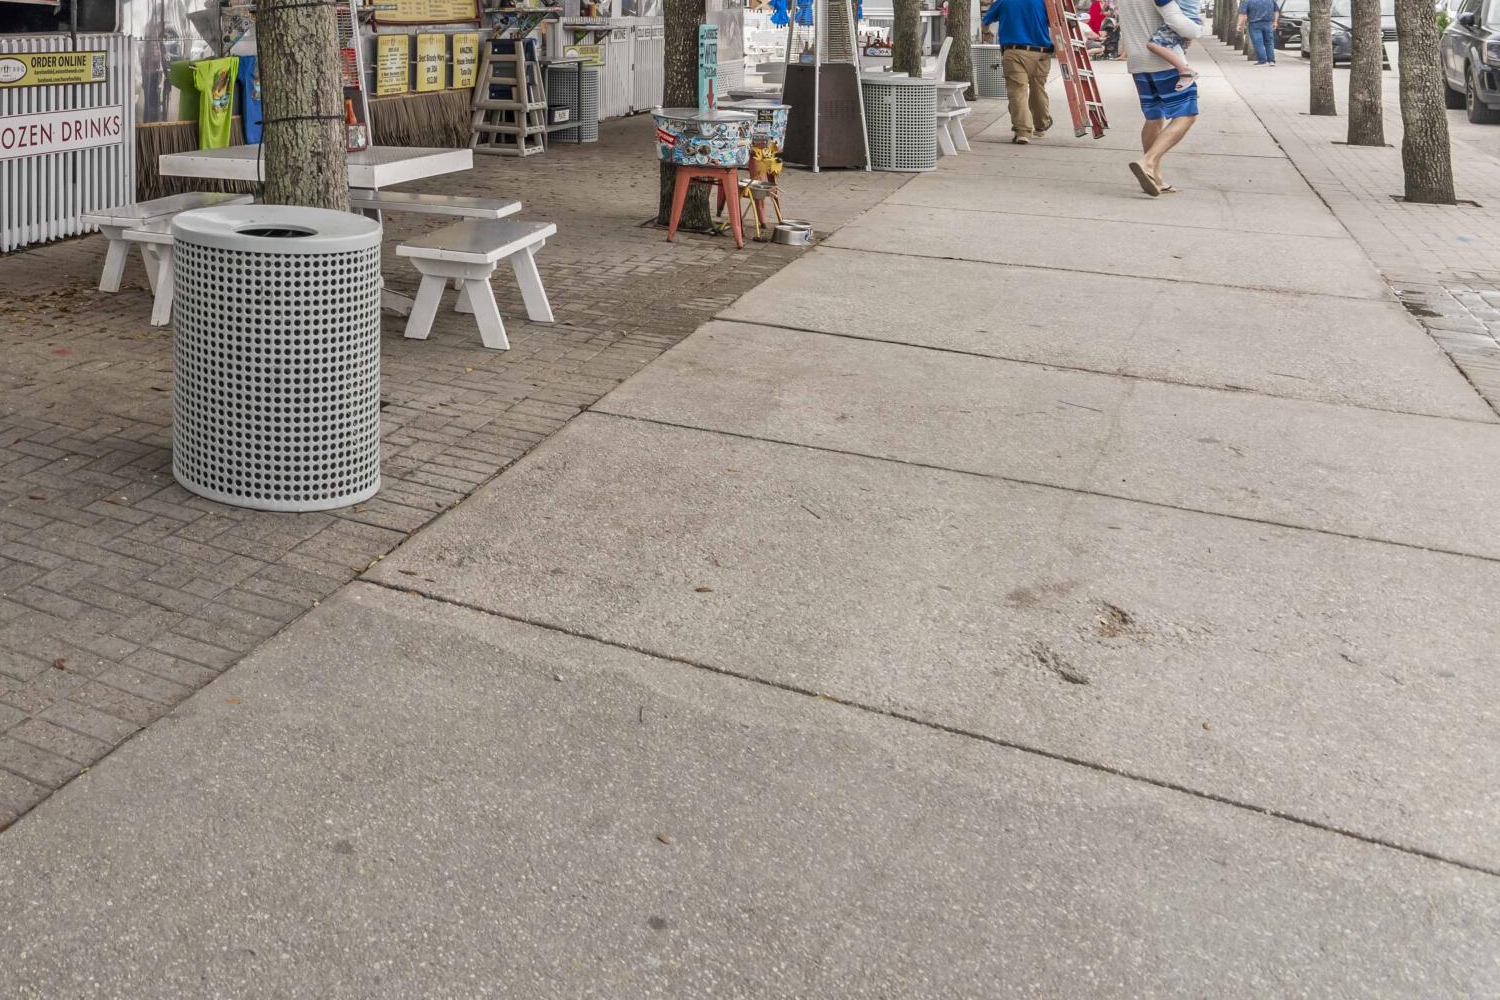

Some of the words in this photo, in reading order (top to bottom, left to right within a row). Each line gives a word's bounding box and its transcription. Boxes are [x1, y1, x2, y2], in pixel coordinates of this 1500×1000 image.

[31, 56, 57, 69] ORDER
[58, 55, 87, 68] ONLINE
[61, 115, 120, 142] DRINKS
